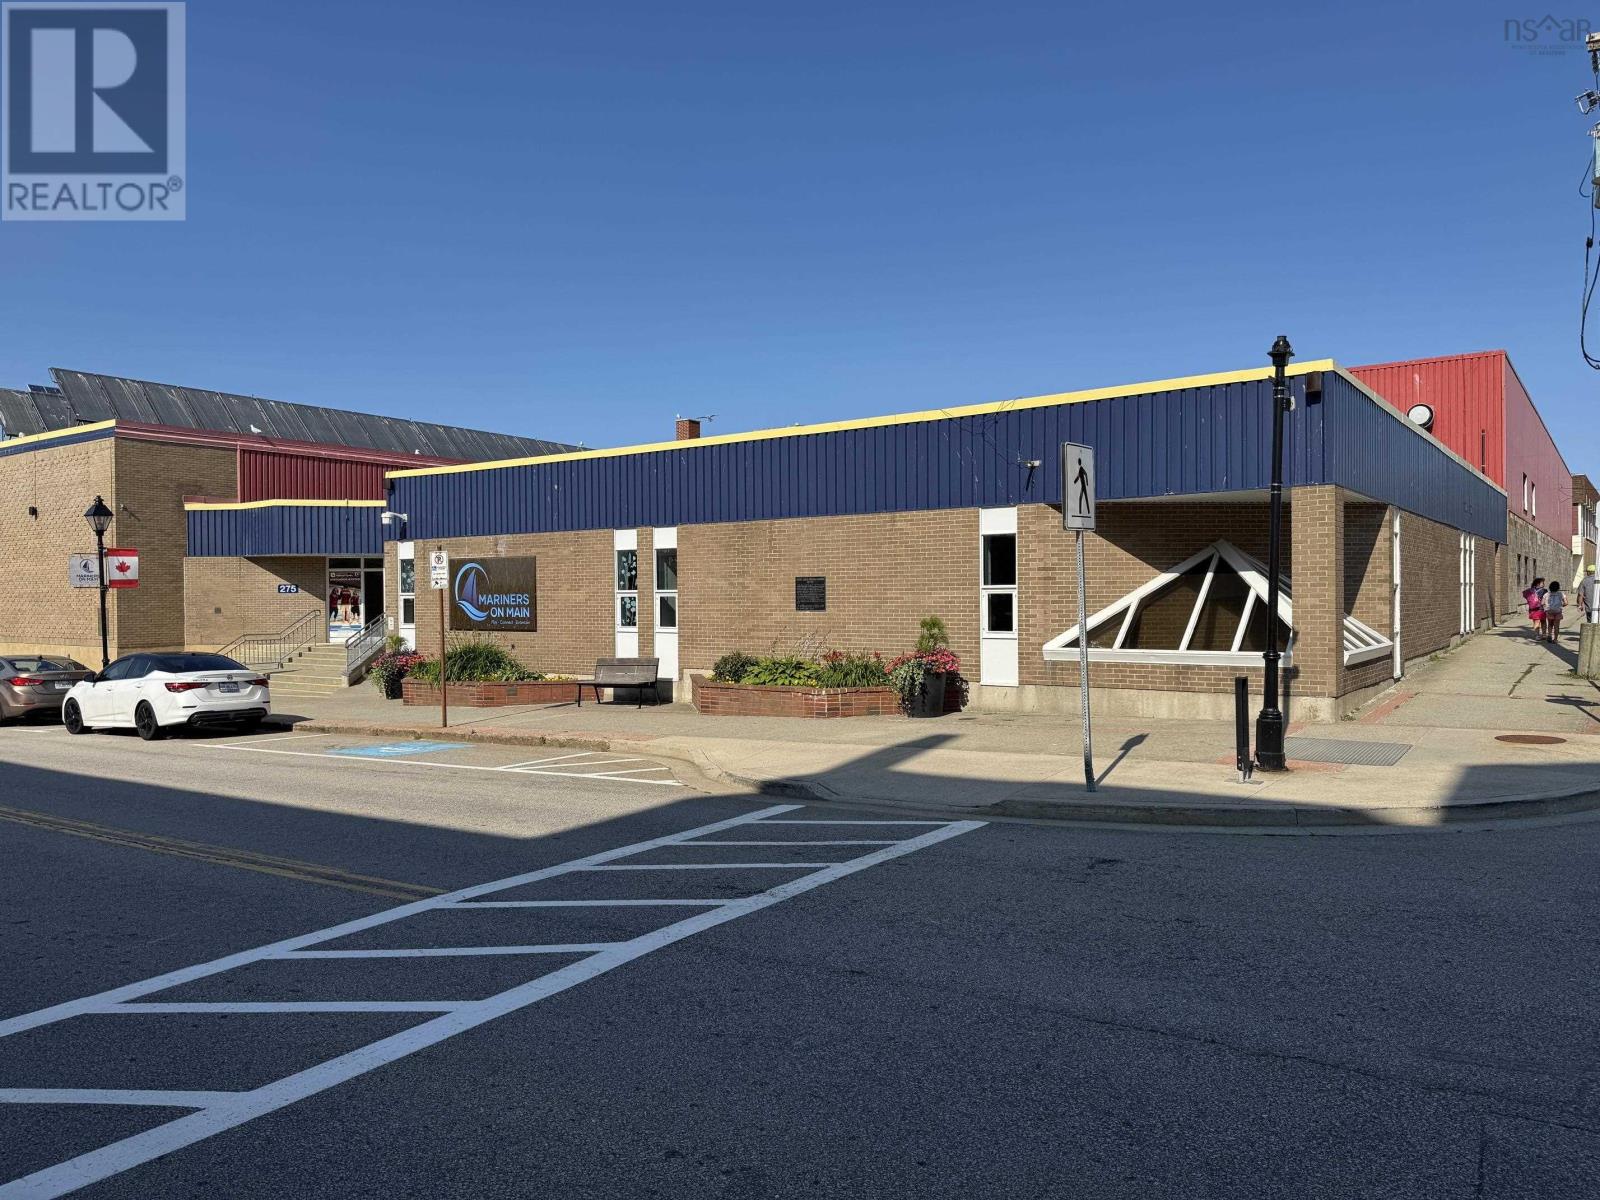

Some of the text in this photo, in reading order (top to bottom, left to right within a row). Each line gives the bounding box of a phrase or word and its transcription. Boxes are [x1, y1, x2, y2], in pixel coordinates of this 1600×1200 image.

[280, 585, 297, 593] 275
[478, 594, 529, 605] MARINERS
[490, 607, 530, 618] ON MAIN
